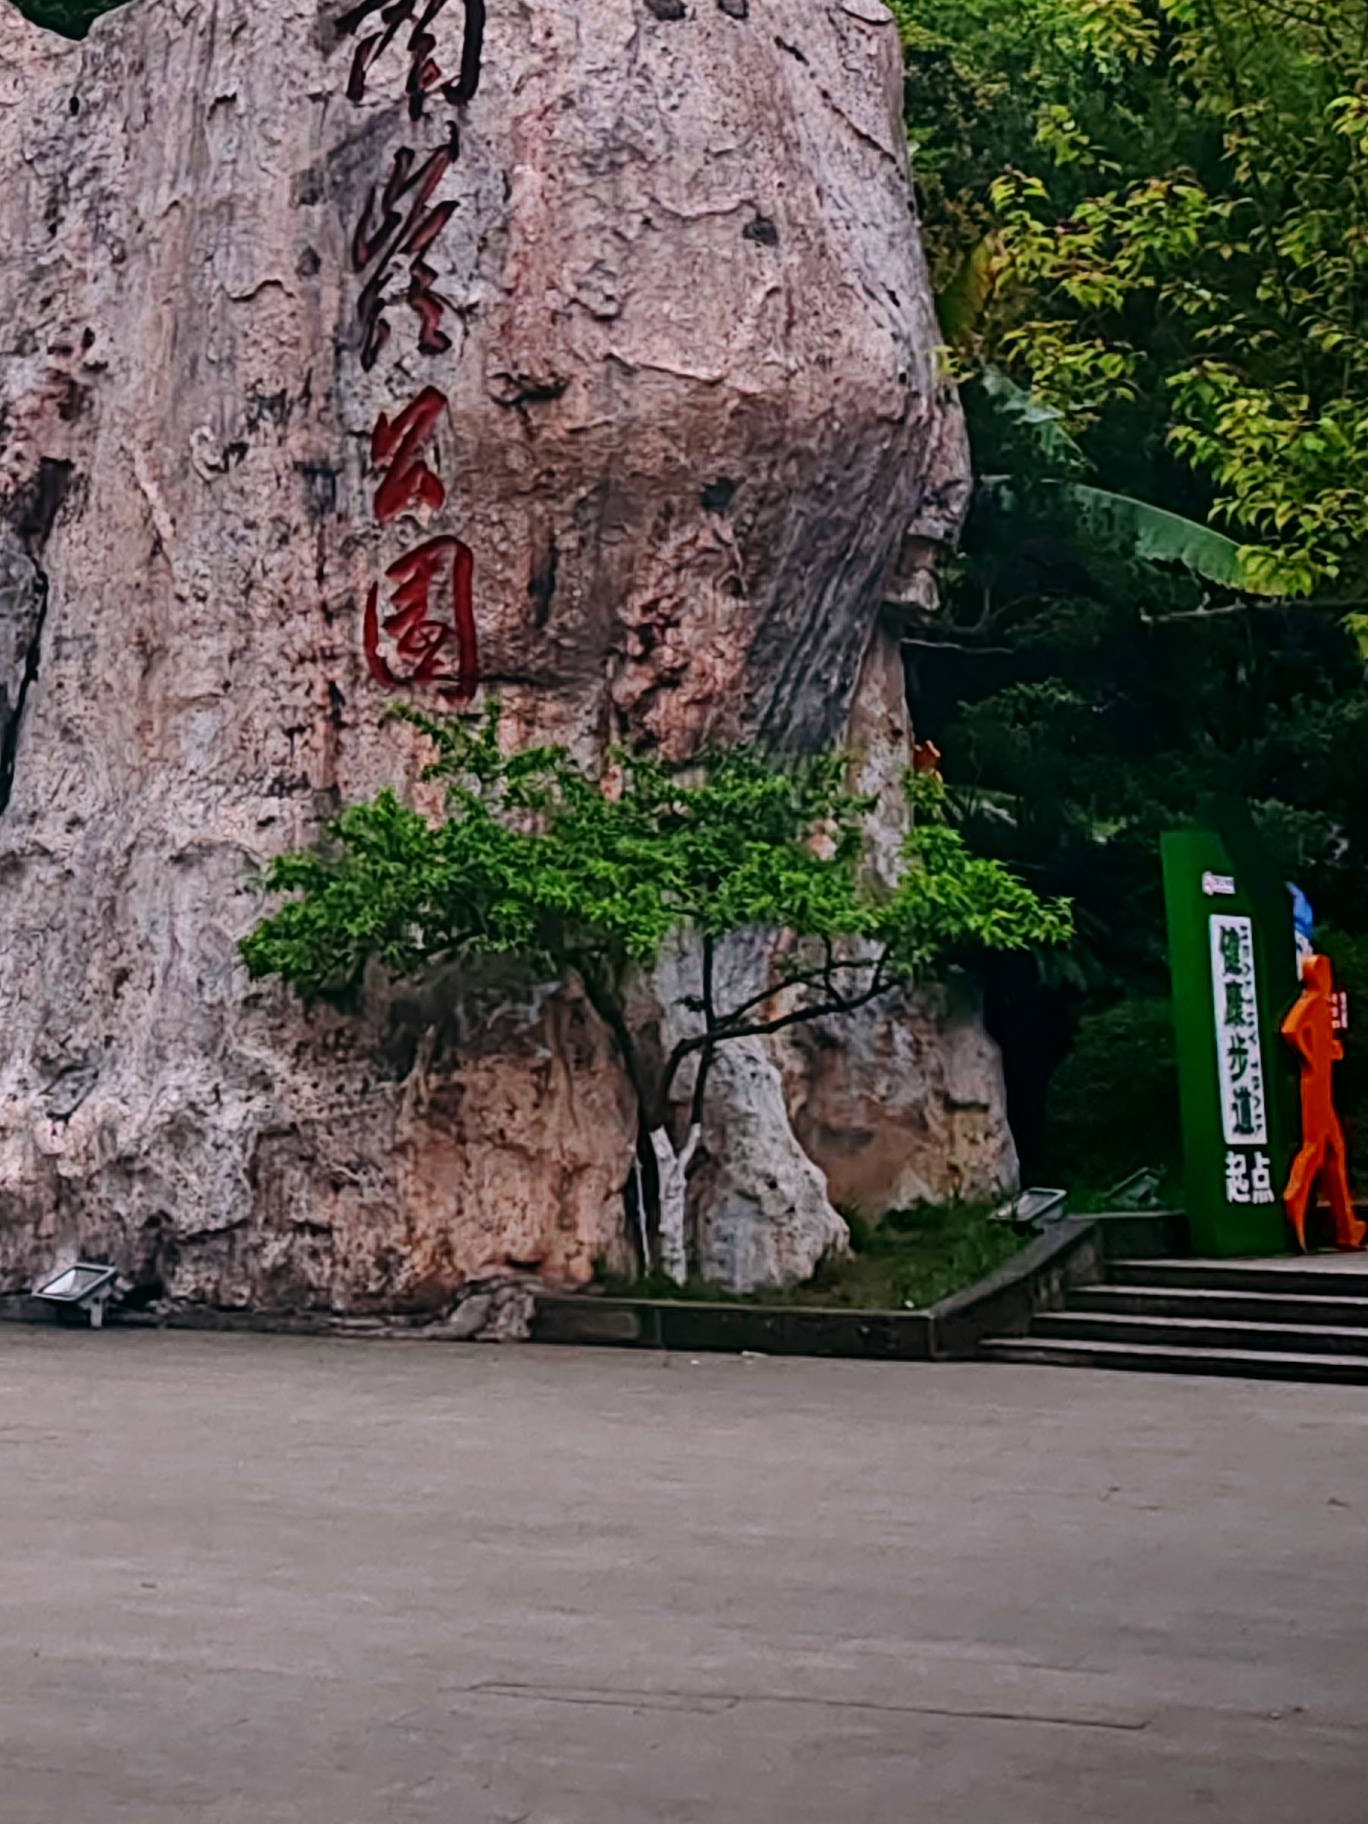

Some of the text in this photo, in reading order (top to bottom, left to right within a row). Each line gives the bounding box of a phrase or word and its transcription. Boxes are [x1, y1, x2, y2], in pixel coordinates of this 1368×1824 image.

[1219, 925, 1255, 1135] 健康步道
[1224, 1151, 1275, 1205] 起点
